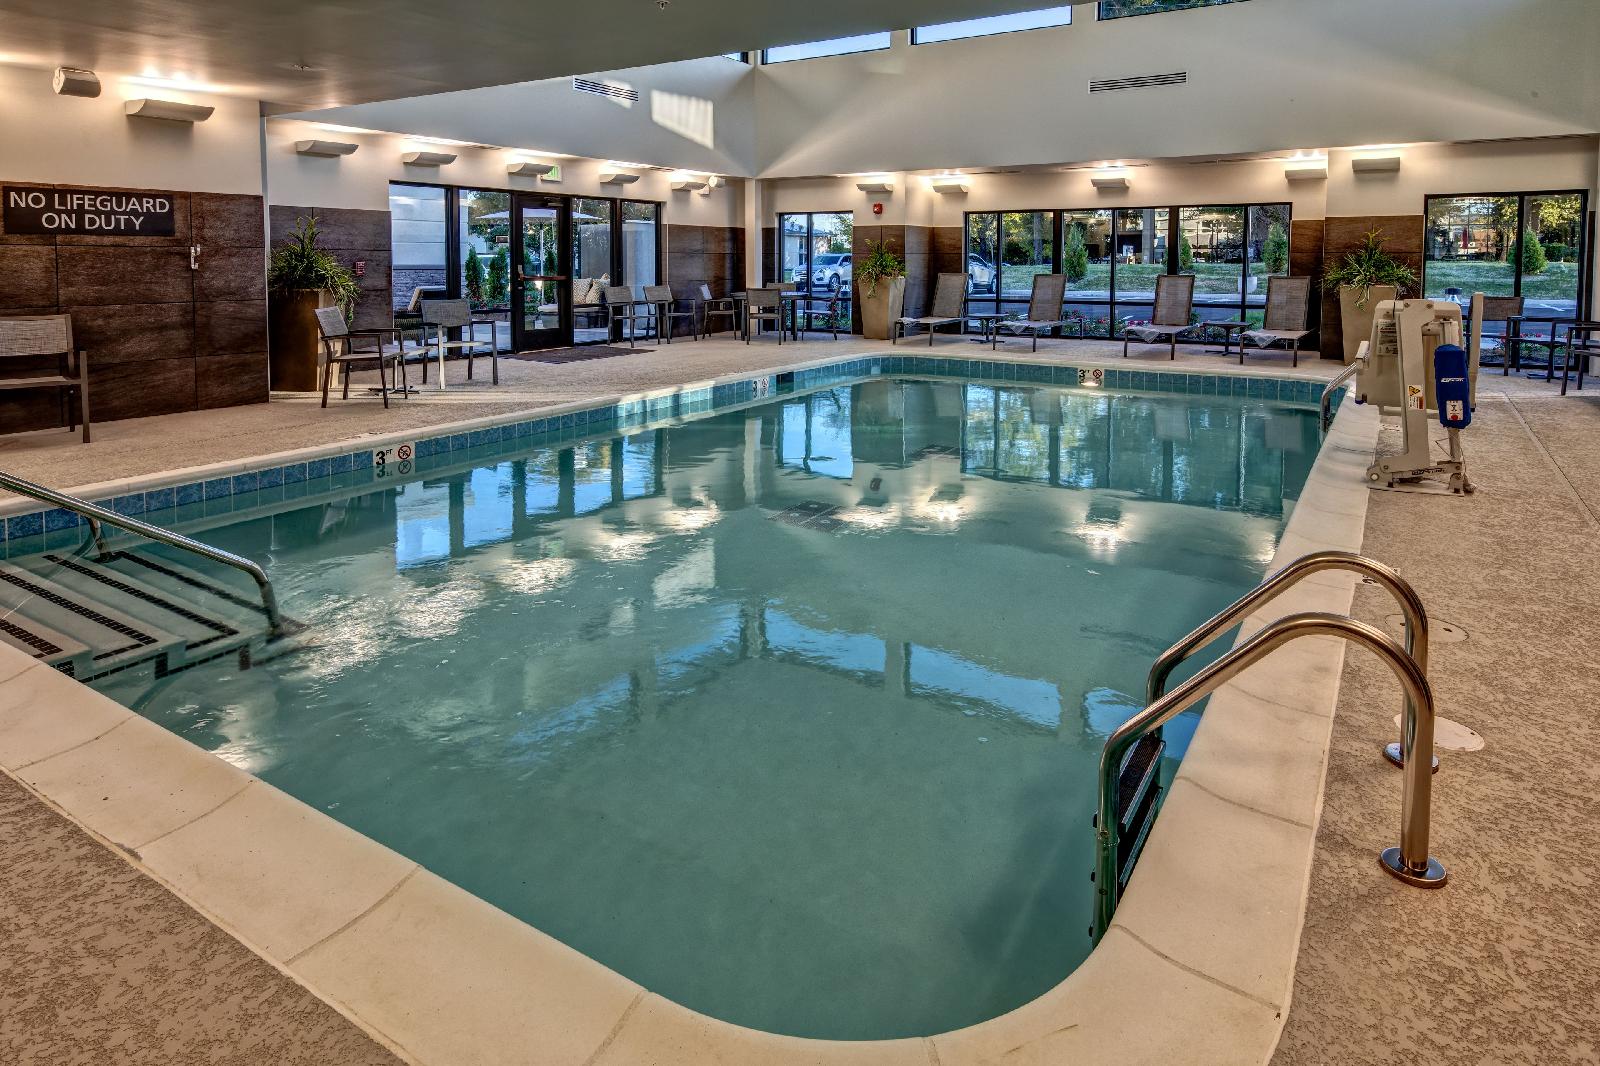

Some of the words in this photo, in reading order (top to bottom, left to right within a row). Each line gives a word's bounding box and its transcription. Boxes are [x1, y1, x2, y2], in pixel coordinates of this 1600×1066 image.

[9, 191, 46, 209] NO
[54, 193, 170, 213] LIFEGUARD
[41, 212, 76, 229] ON
[84, 213, 145, 231] DUTY
[1079, 369, 1085, 378] 3
[375, 450, 386, 465] 3
[385, 448, 393, 456] FT
